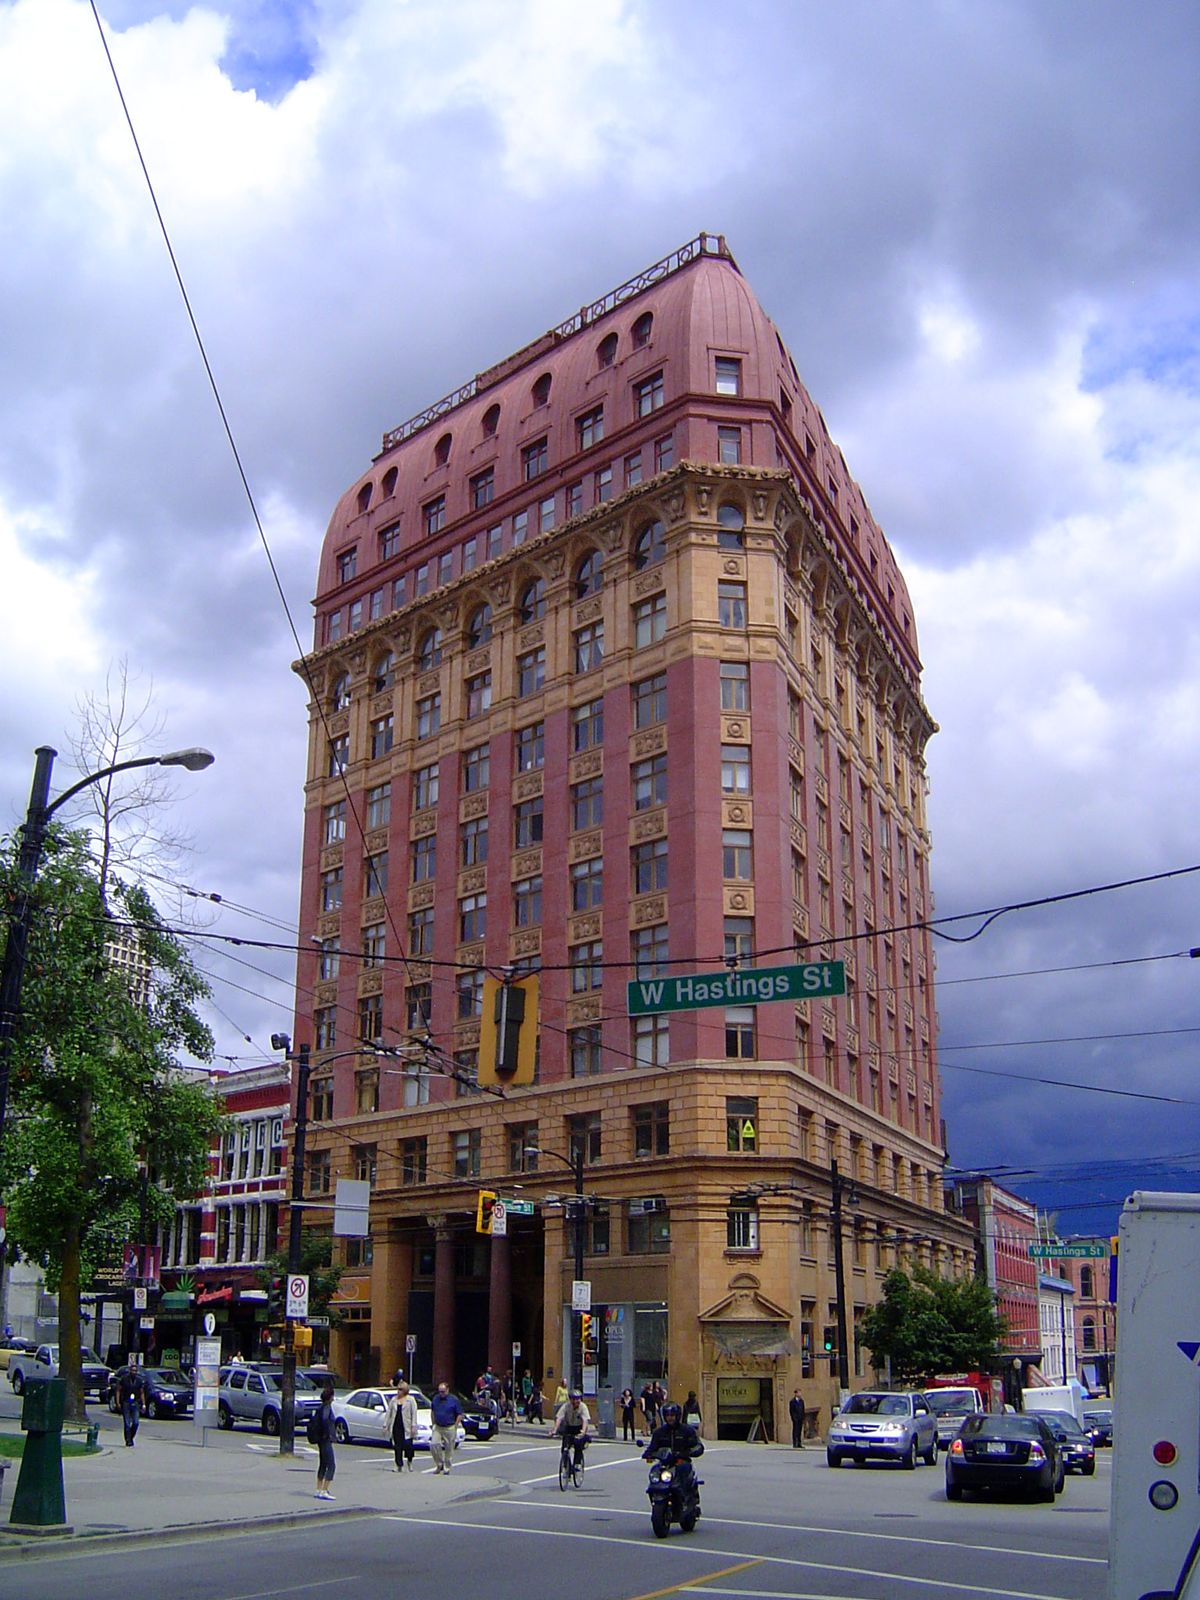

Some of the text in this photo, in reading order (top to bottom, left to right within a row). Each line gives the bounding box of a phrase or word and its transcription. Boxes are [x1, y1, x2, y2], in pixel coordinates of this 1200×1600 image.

[640, 966, 832, 1005] W Hastings St
[1032, 1246, 1101, 1257] W Hastings St
